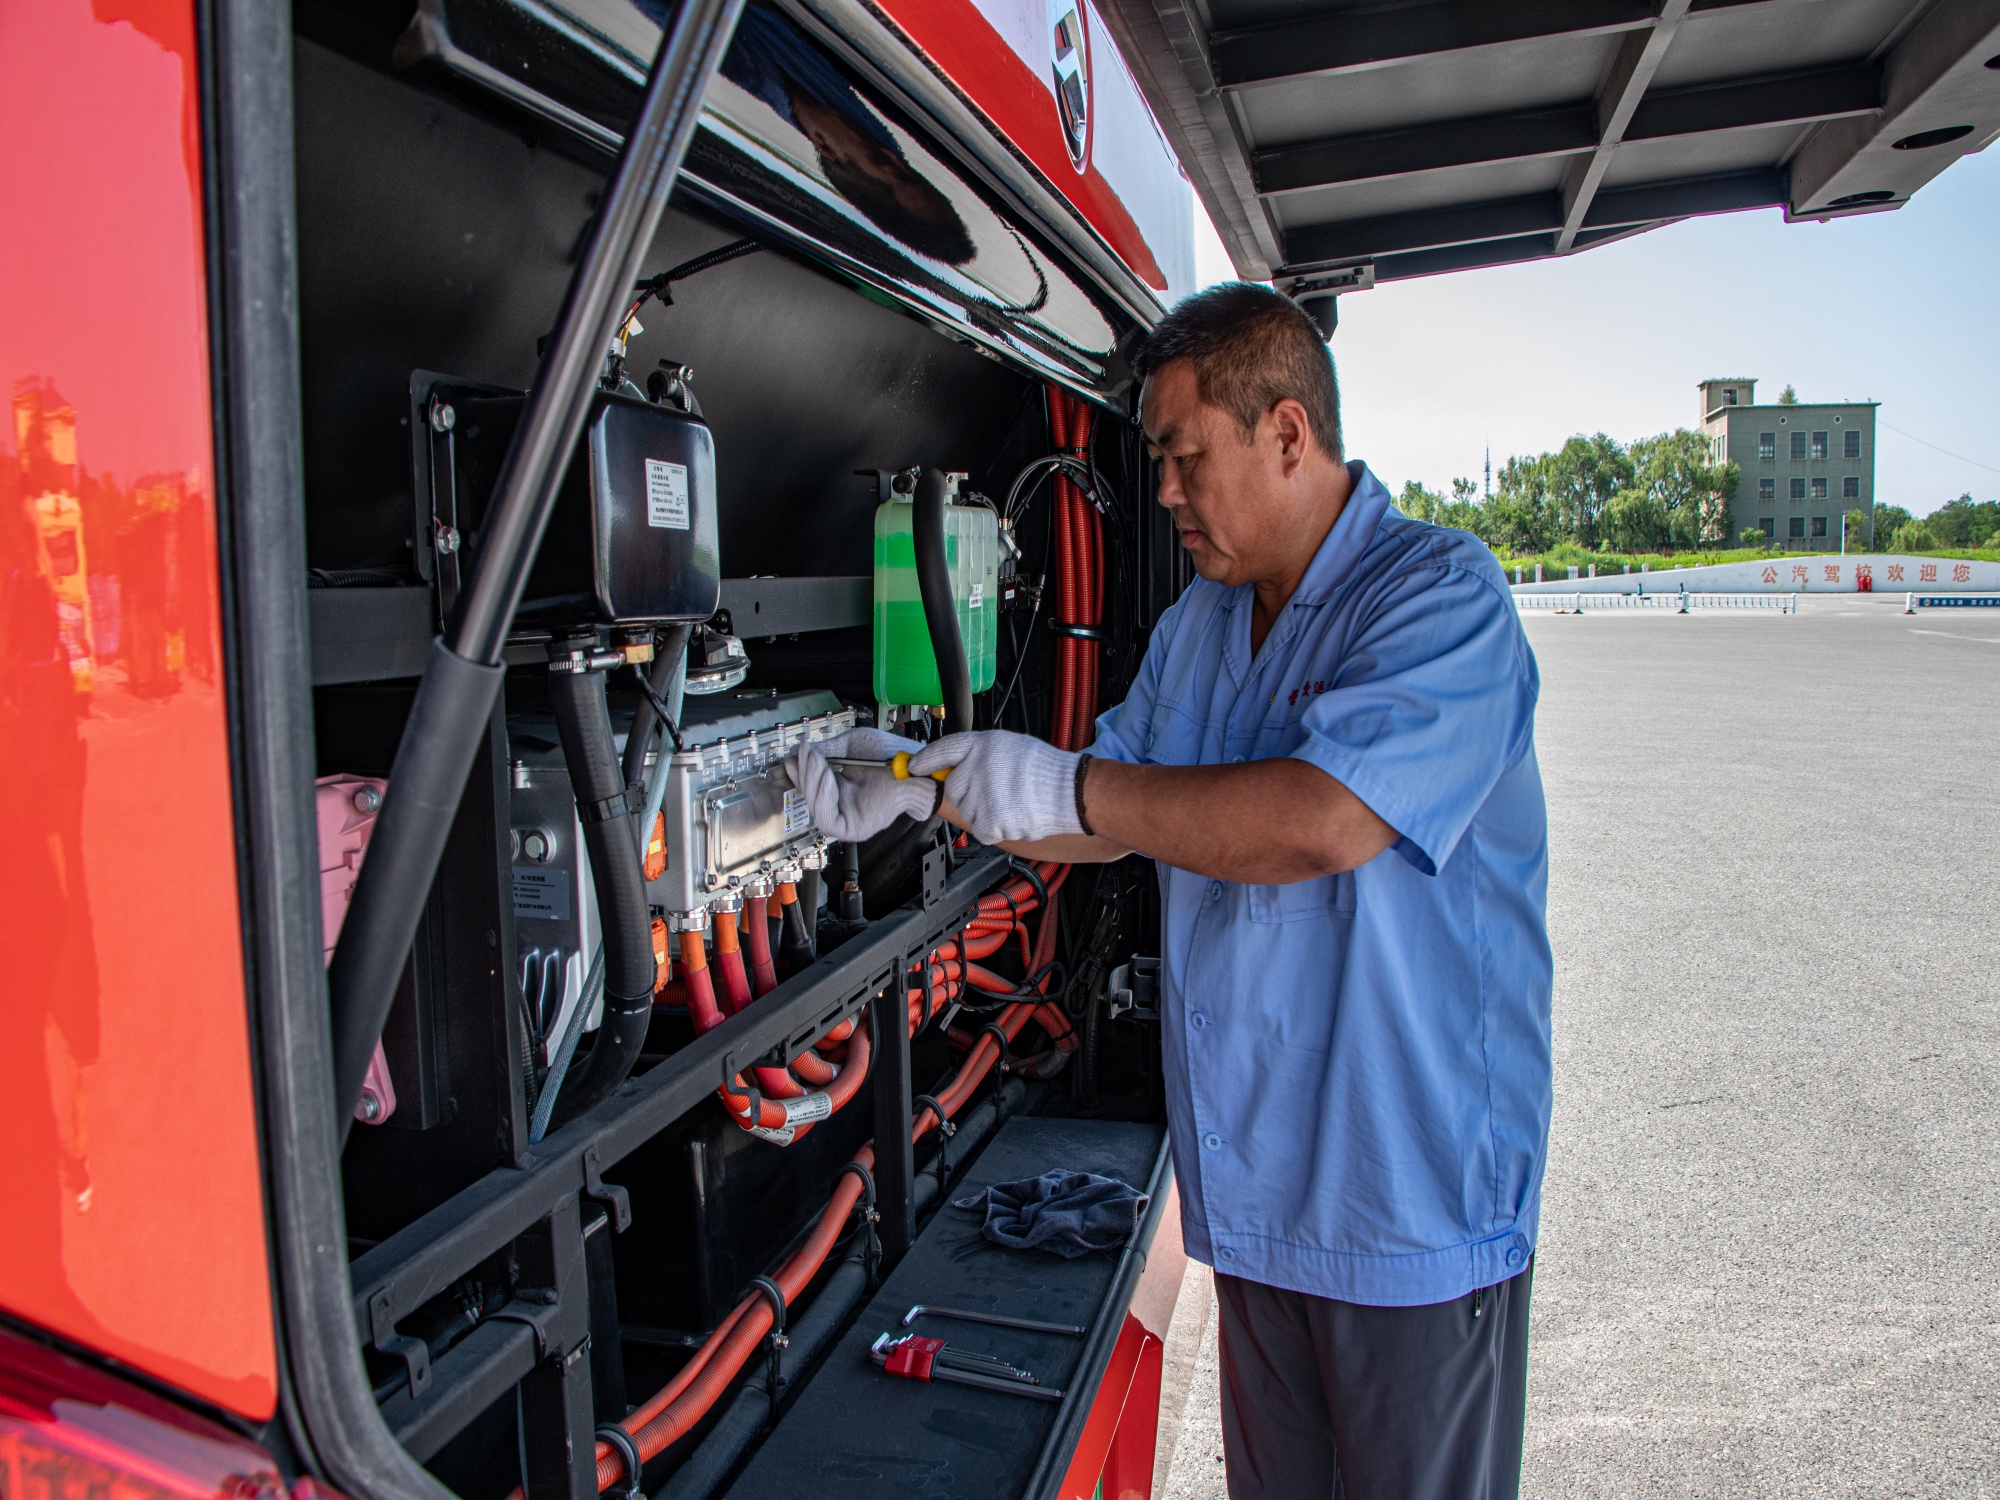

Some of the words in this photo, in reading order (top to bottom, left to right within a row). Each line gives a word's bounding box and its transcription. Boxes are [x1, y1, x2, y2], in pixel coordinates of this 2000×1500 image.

[1761, 564, 1971, 583] 公汽驾校欢迎您
